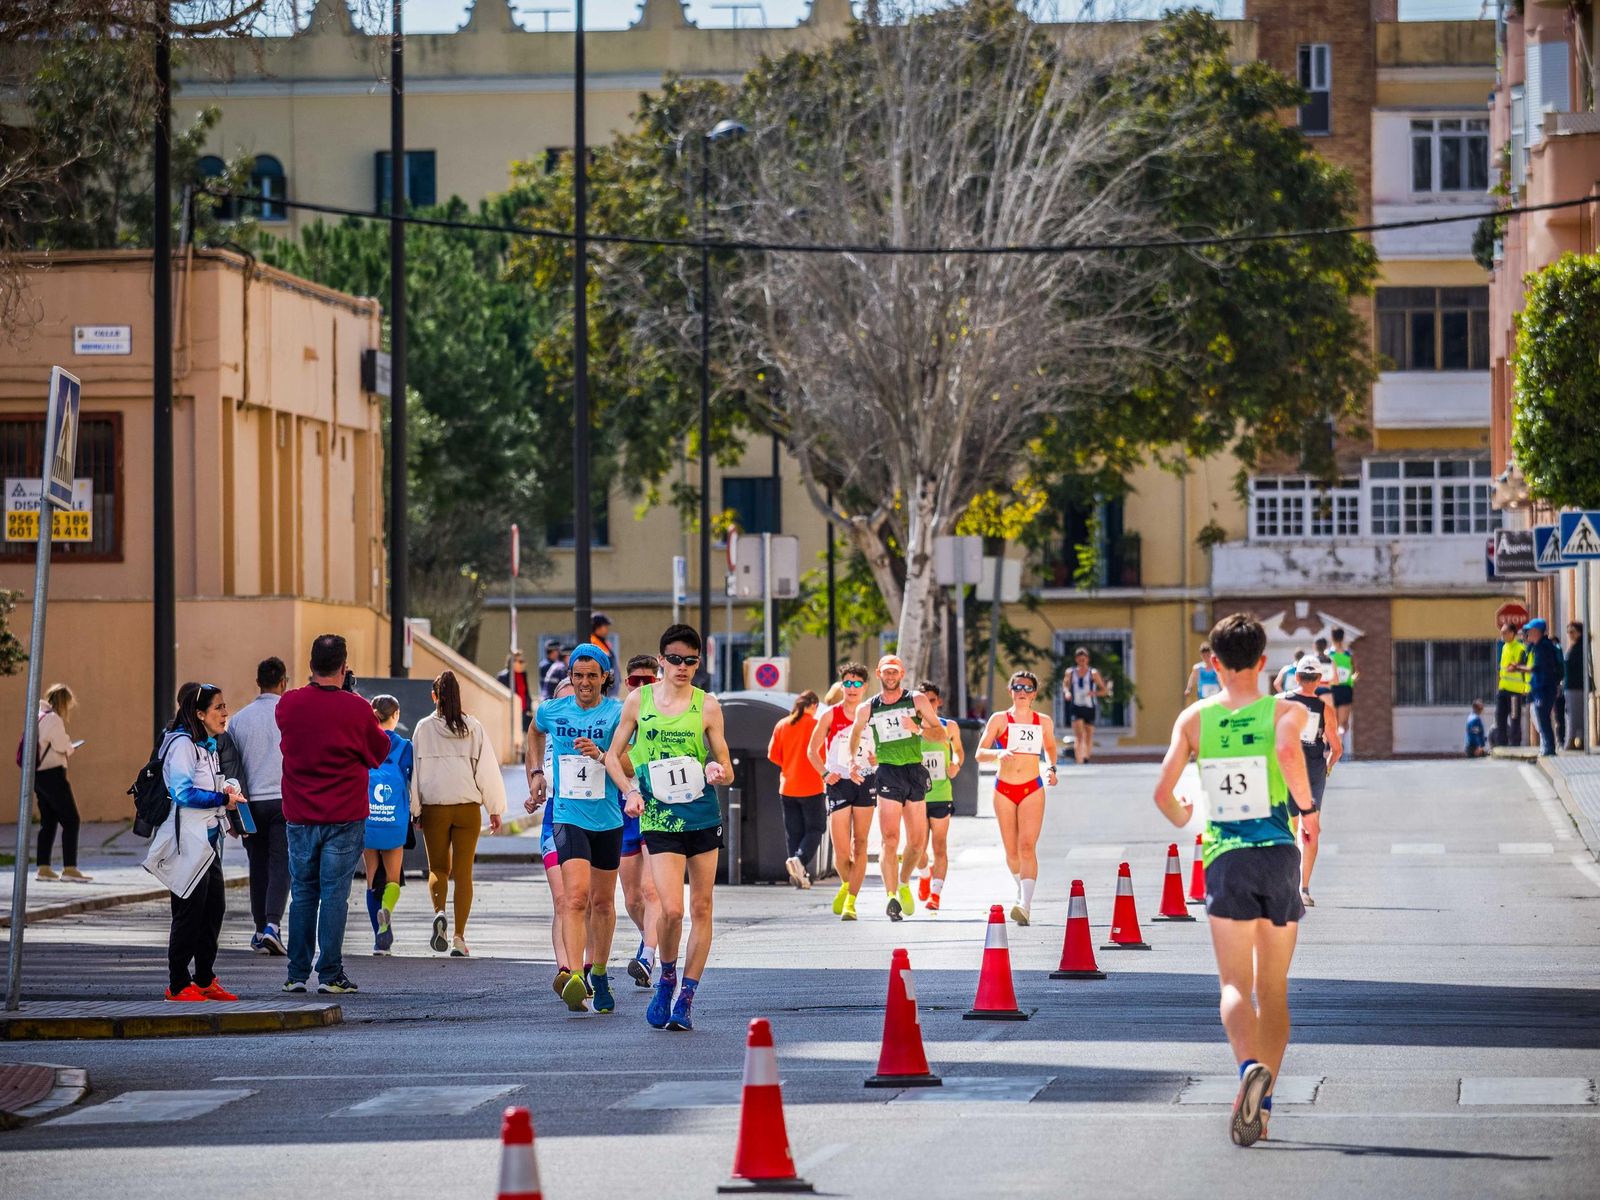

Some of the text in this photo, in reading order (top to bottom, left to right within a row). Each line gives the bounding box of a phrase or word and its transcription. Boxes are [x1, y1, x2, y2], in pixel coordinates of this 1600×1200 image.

[15, 501, 84, 511] DISPLE
[9, 515, 33, 526] 956
[65, 515, 89, 526] 189
[9, 527, 32, 538] 601
[65, 527, 88, 538] 414
[1500, 614, 1527, 625] STOP
[886, 717, 900, 729] 34
[557, 725, 604, 740] nerja
[660, 729, 696, 738] Fundación
[1020, 729, 1034, 741] 28
[924, 758, 938, 769] 40
[576, 766, 587, 782] 4
[668, 767, 689, 786] 11
[1219, 773, 1248, 795] 43
